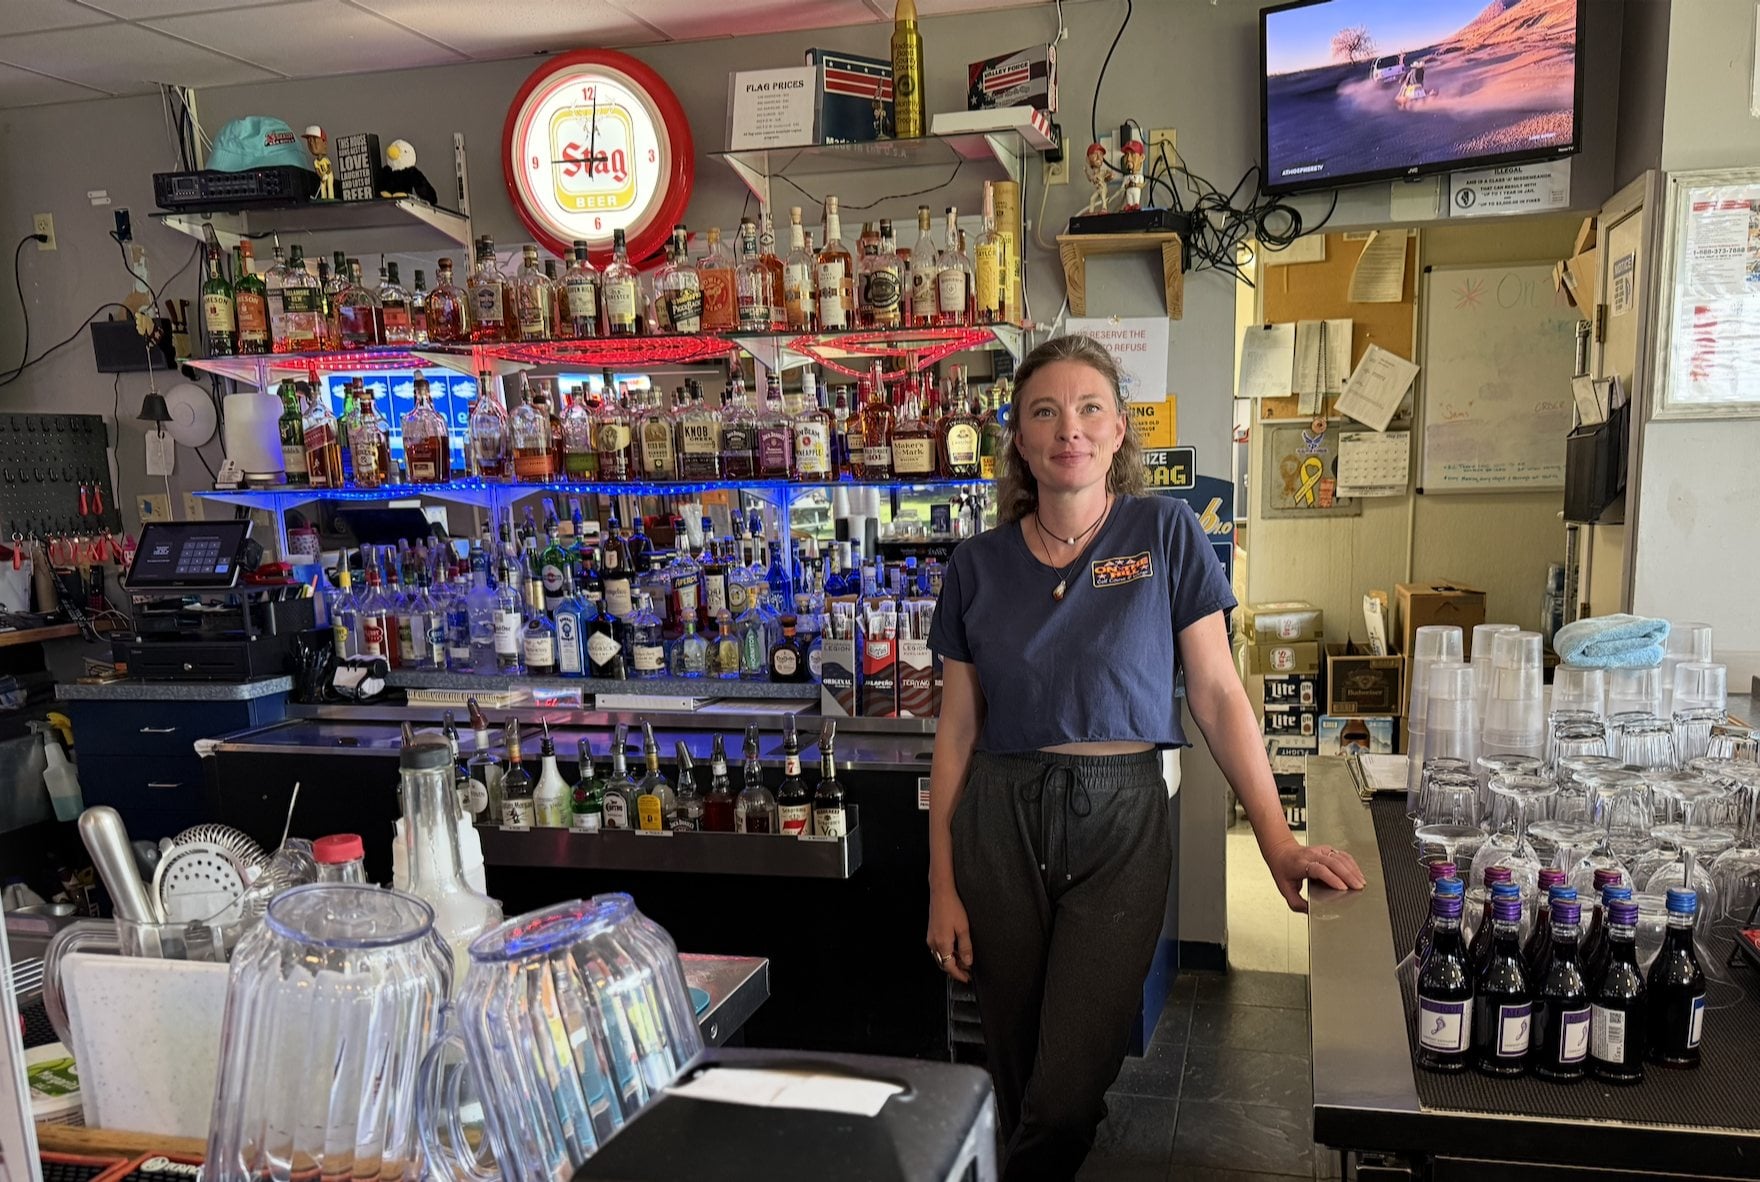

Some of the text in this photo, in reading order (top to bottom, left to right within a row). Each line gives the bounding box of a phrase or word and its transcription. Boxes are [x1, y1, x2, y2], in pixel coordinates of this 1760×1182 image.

[984, 61, 1029, 78] VALLEY FORGE
[746, 80, 804, 93] FLAG PRICES
[582, 87, 594, 101] 12
[339, 152, 369, 172] LOVE
[532, 156, 539, 169] 9
[562, 142, 628, 182] Stag
[648, 150, 655, 163] 3
[341, 169, 370, 180] LAUGHTER
[1495, 167, 1523, 175] ILLEGAL
[576, 195, 618, 208] BEER
[594, 217, 601, 229] 6
[1614, 257, 1632, 274] NOTICE
[1089, 331, 1128, 339] RESERVE
[1129, 330, 1147, 339] THE
[1115, 344, 1148, 352] REFUSE
[684, 425, 708, 438] KNOB
[894, 442, 924, 450] Maker's
[823, 678, 853, 686] ORIGINAL
[903, 679, 931, 688] TERIYAKI
[1272, 682, 1296, 698] Lite
[1348, 688, 1384, 697] Budweiser
[1272, 714, 1297, 729] Lite
[787, 762, 795, 773] 7
[783, 819, 808, 837] 7
